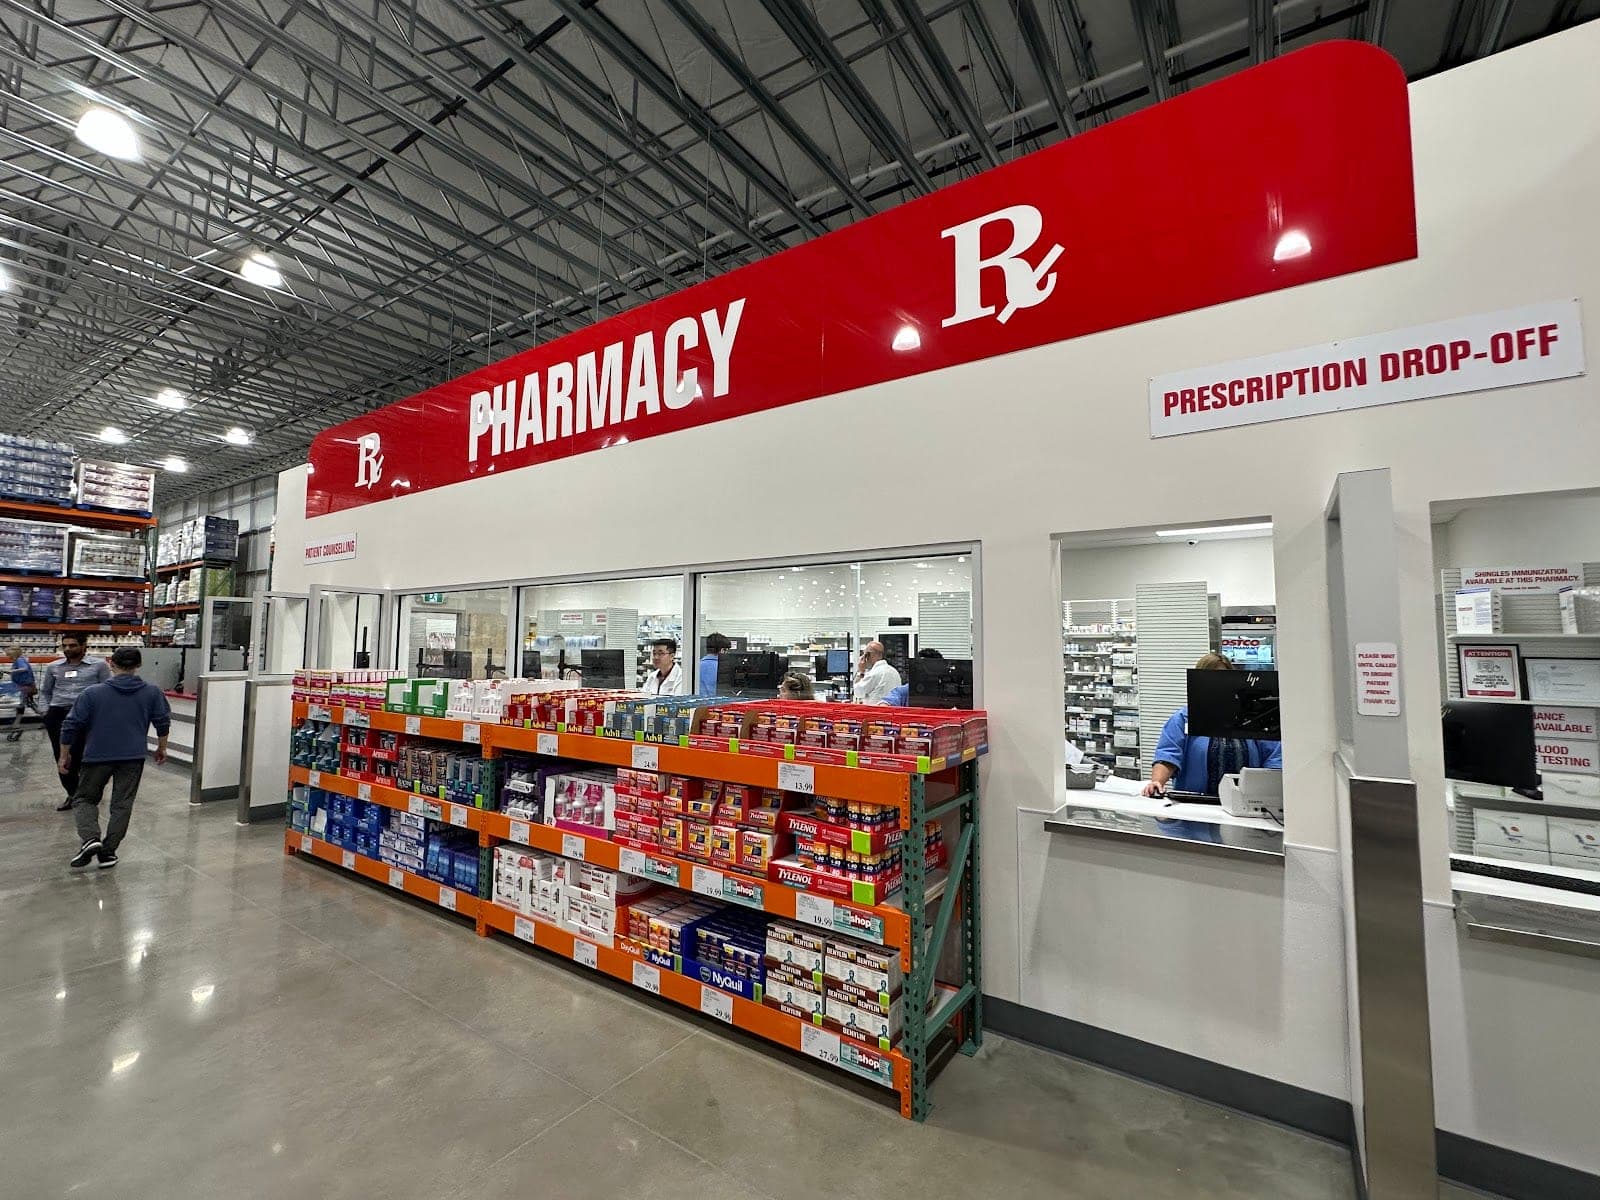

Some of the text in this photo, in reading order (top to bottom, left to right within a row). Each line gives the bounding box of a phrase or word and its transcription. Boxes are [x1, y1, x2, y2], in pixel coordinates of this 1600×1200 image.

[1163, 323, 1559, 417] PRESCRIPTION DROP-OFF
[469, 298, 746, 462] PHARMACY
[305, 540, 354, 558] PATIENT COUNSELLING
[1512, 568, 1568, 576] IMMUNIZATION
[568, 725, 582, 733] Advil
[605, 729, 620, 737] Advil
[1535, 723, 1593, 734] AVAILABLE
[646, 734, 663, 742] Advil
[1542, 755, 1591, 767] TESTING
[795, 782, 813, 791] 13.99
[788, 818, 817, 835] TYLENOL
[884, 831, 903, 844] TYLEN
[798, 842, 814, 851] TYLEN
[778, 868, 812, 885] TYLENOL
[814, 915, 832, 927] 19.99
[620, 943, 639, 954] DayQuil
[827, 947, 848, 958] BENYLIN
[652, 953, 670, 966] NyQuil
[857, 956, 879, 968] BENYLIN
[781, 964, 801, 975] BENYLIN
[712, 971, 743, 992] NyQuil
[827, 989, 849, 1001] BENYLIN
[843, 984, 866, 997] BENYLIN
[781, 1005, 801, 1017] BENYLIN
[858, 1000, 880, 1013] BENYLIN
[843, 1027, 866, 1041] BENYLIN
[819, 1050, 838, 1063] 27.99
